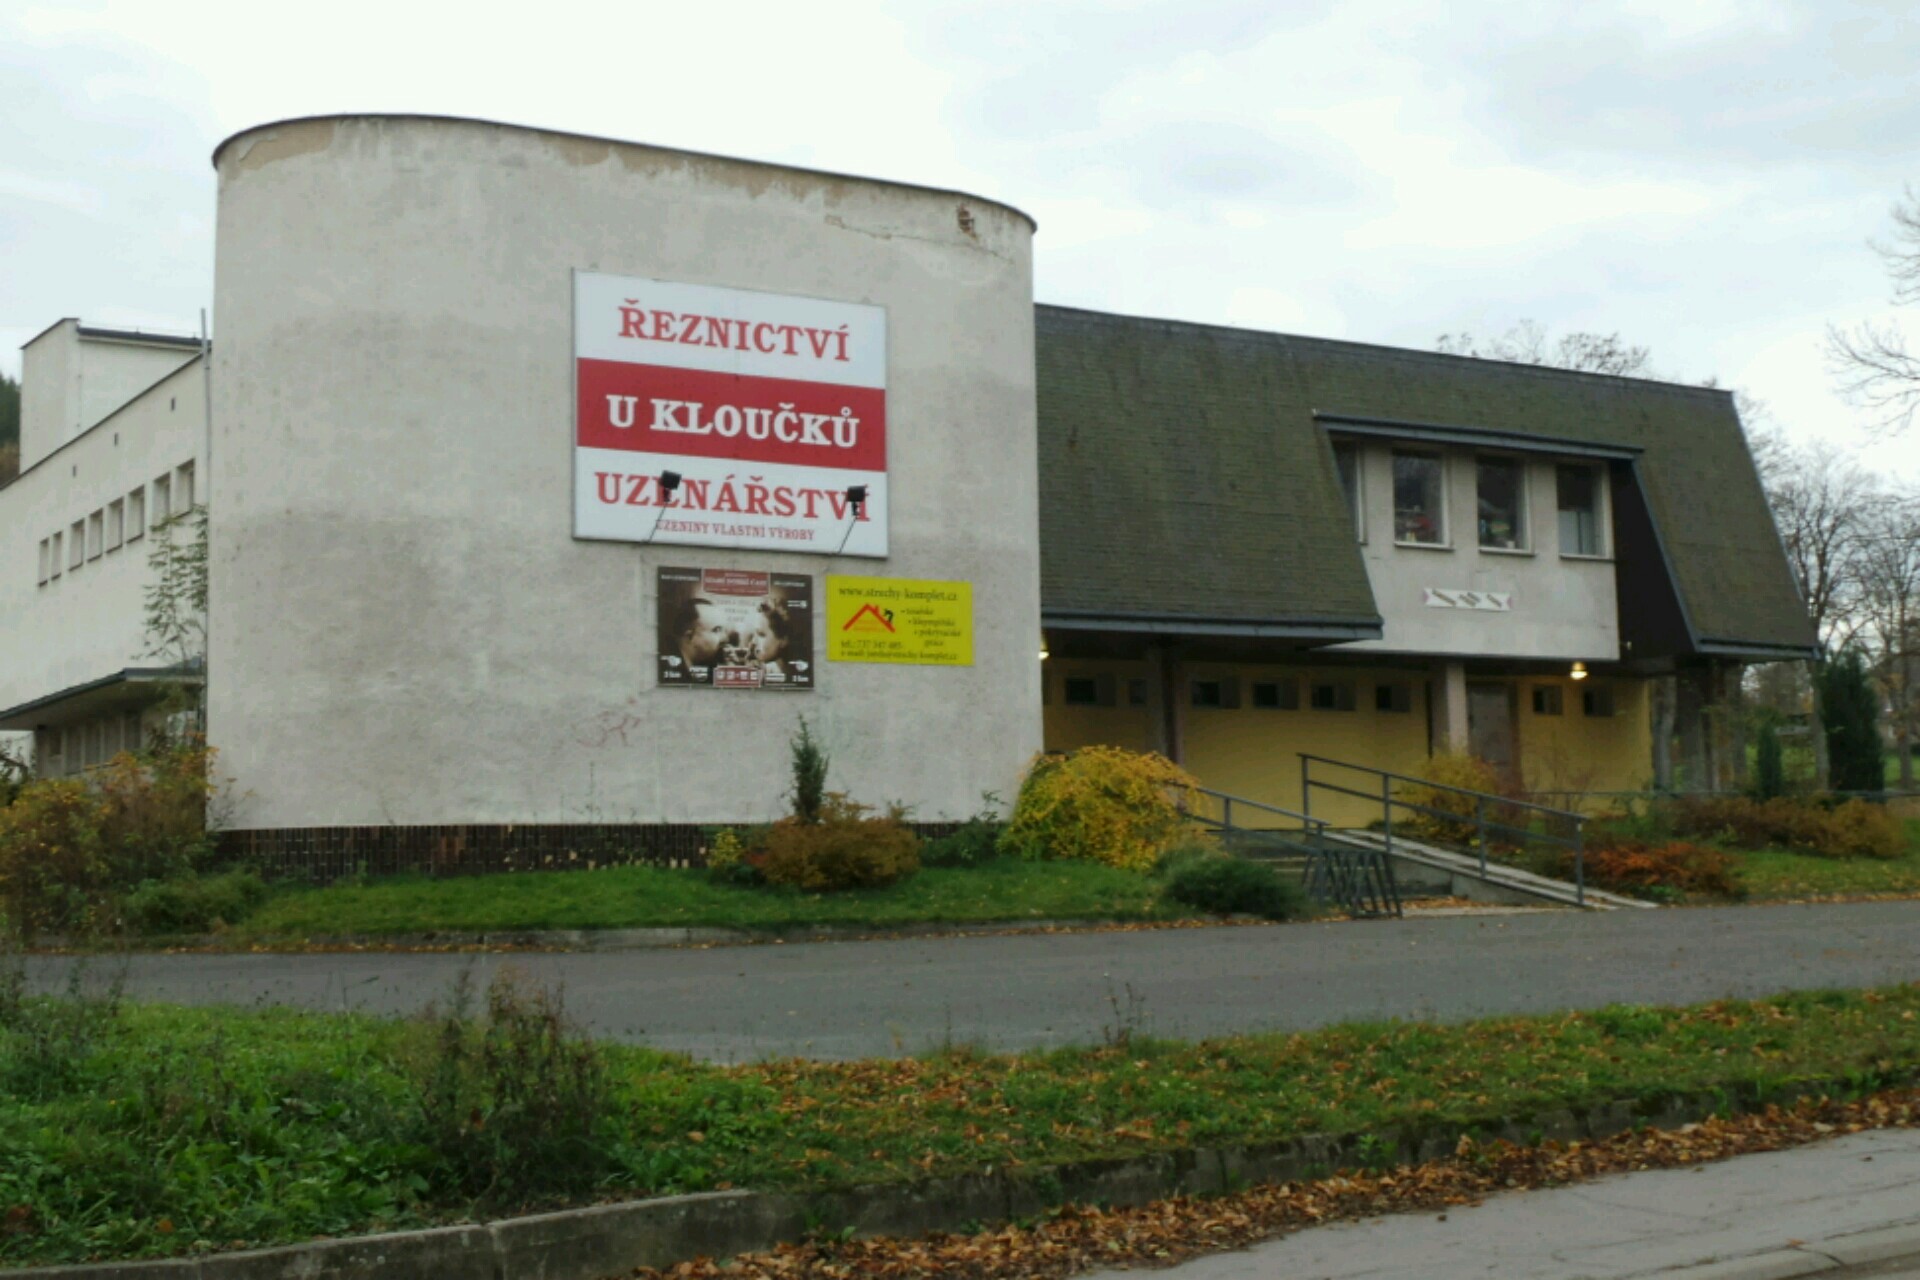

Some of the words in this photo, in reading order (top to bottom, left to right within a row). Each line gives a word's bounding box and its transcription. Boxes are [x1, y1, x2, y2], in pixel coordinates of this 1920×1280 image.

[618, 299, 851, 362] ŘEZNICTVÍ
[606, 395, 638, 428] U
[649, 399, 859, 448] KLOUČKŮ
[712, 523, 766, 539] VLASTNÍ
[769, 526, 815, 541] VÝROBY
